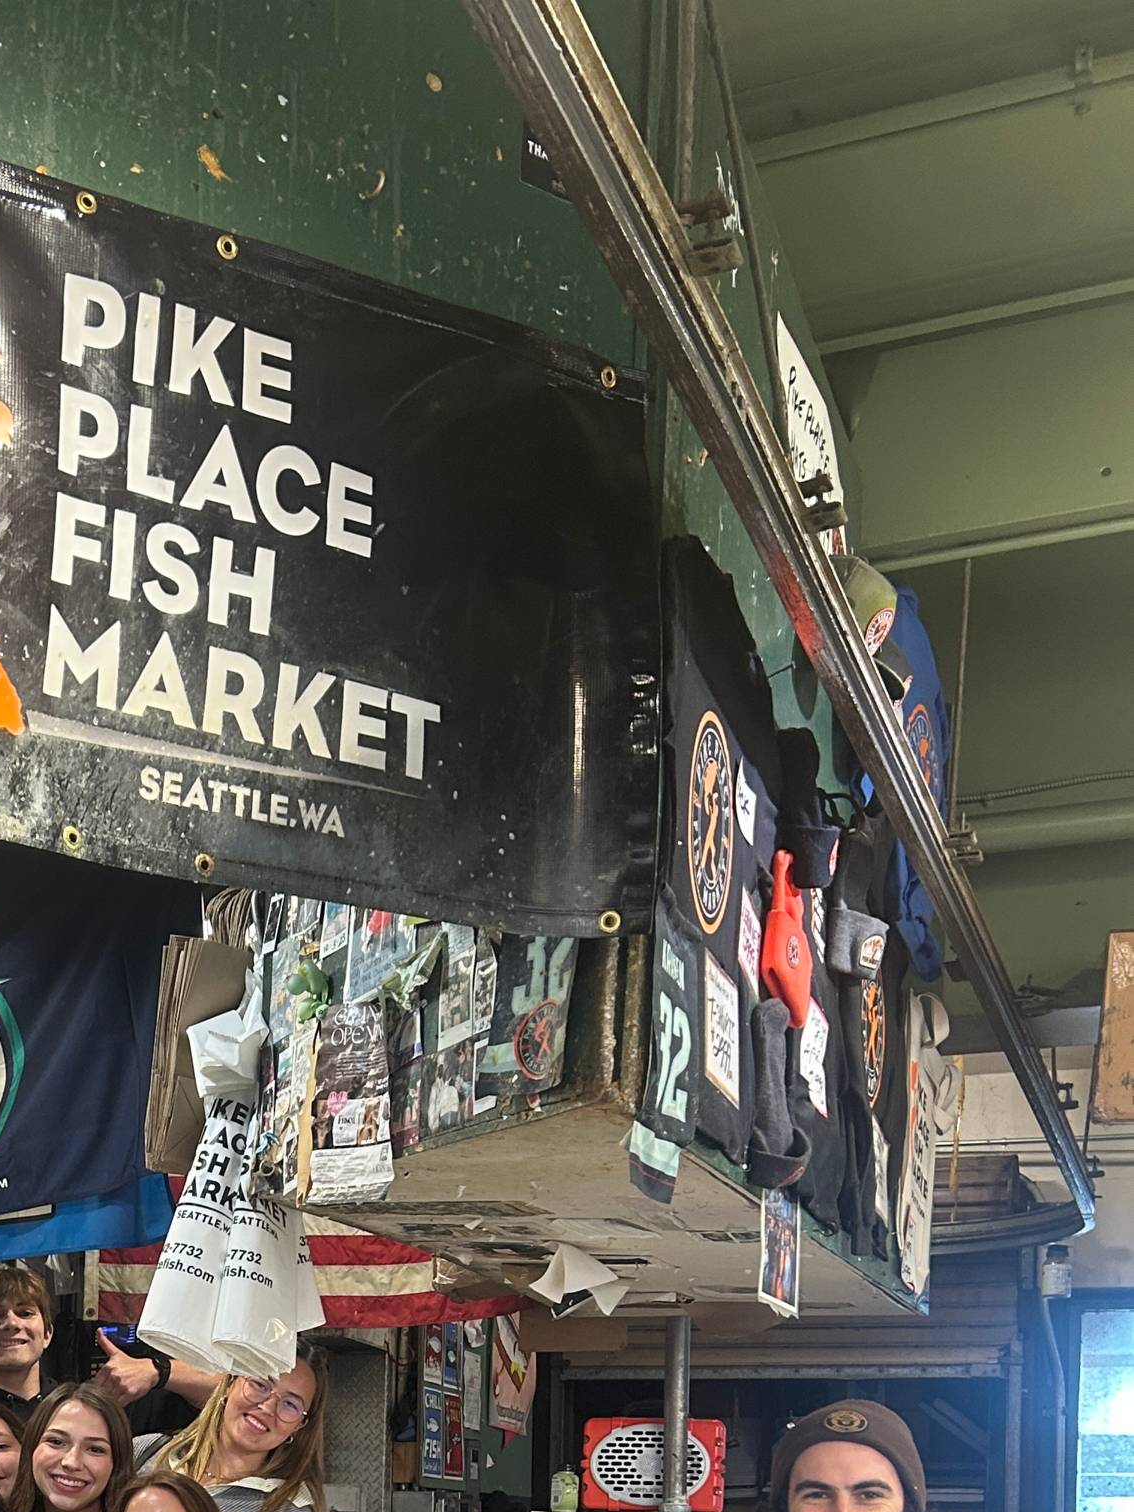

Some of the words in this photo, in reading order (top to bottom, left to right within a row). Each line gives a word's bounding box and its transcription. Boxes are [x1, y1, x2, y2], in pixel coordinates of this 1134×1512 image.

[61, 272, 293, 424] PIKE
[57, 382, 373, 558] PLACE
[51, 491, 275, 636] FISH
[42, 604, 441, 780] MARKET
[208, 1098, 249, 1126] IKE
[234, 1215, 279, 1240] EATTLE,WA
